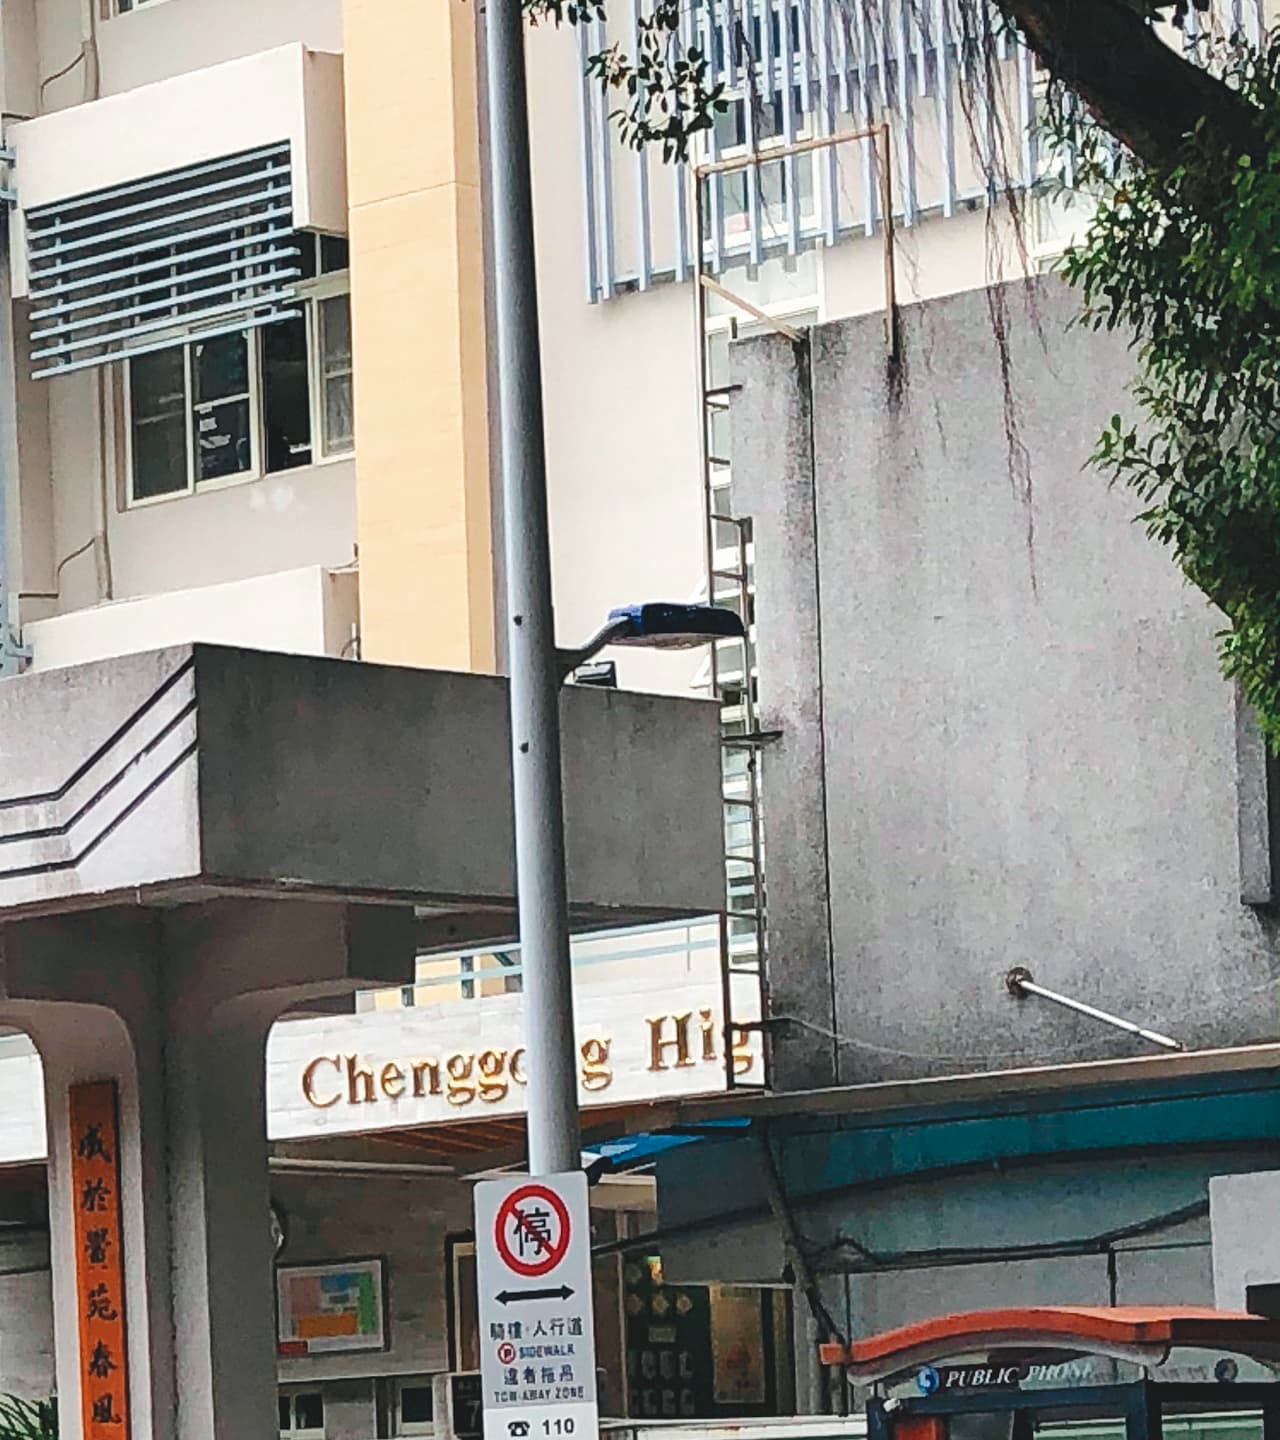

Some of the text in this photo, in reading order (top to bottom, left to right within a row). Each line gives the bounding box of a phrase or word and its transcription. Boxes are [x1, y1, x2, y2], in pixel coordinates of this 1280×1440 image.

[301, 1036, 613, 1108] Chenggog
[513, 1207, 551, 1257] 停
[519, 1343, 575, 1360] SIDEWALK
[945, 1367, 1020, 1388] PUBLIC
[555, 1386, 584, 1399] ZONE
[542, 1418, 575, 1436] 110
